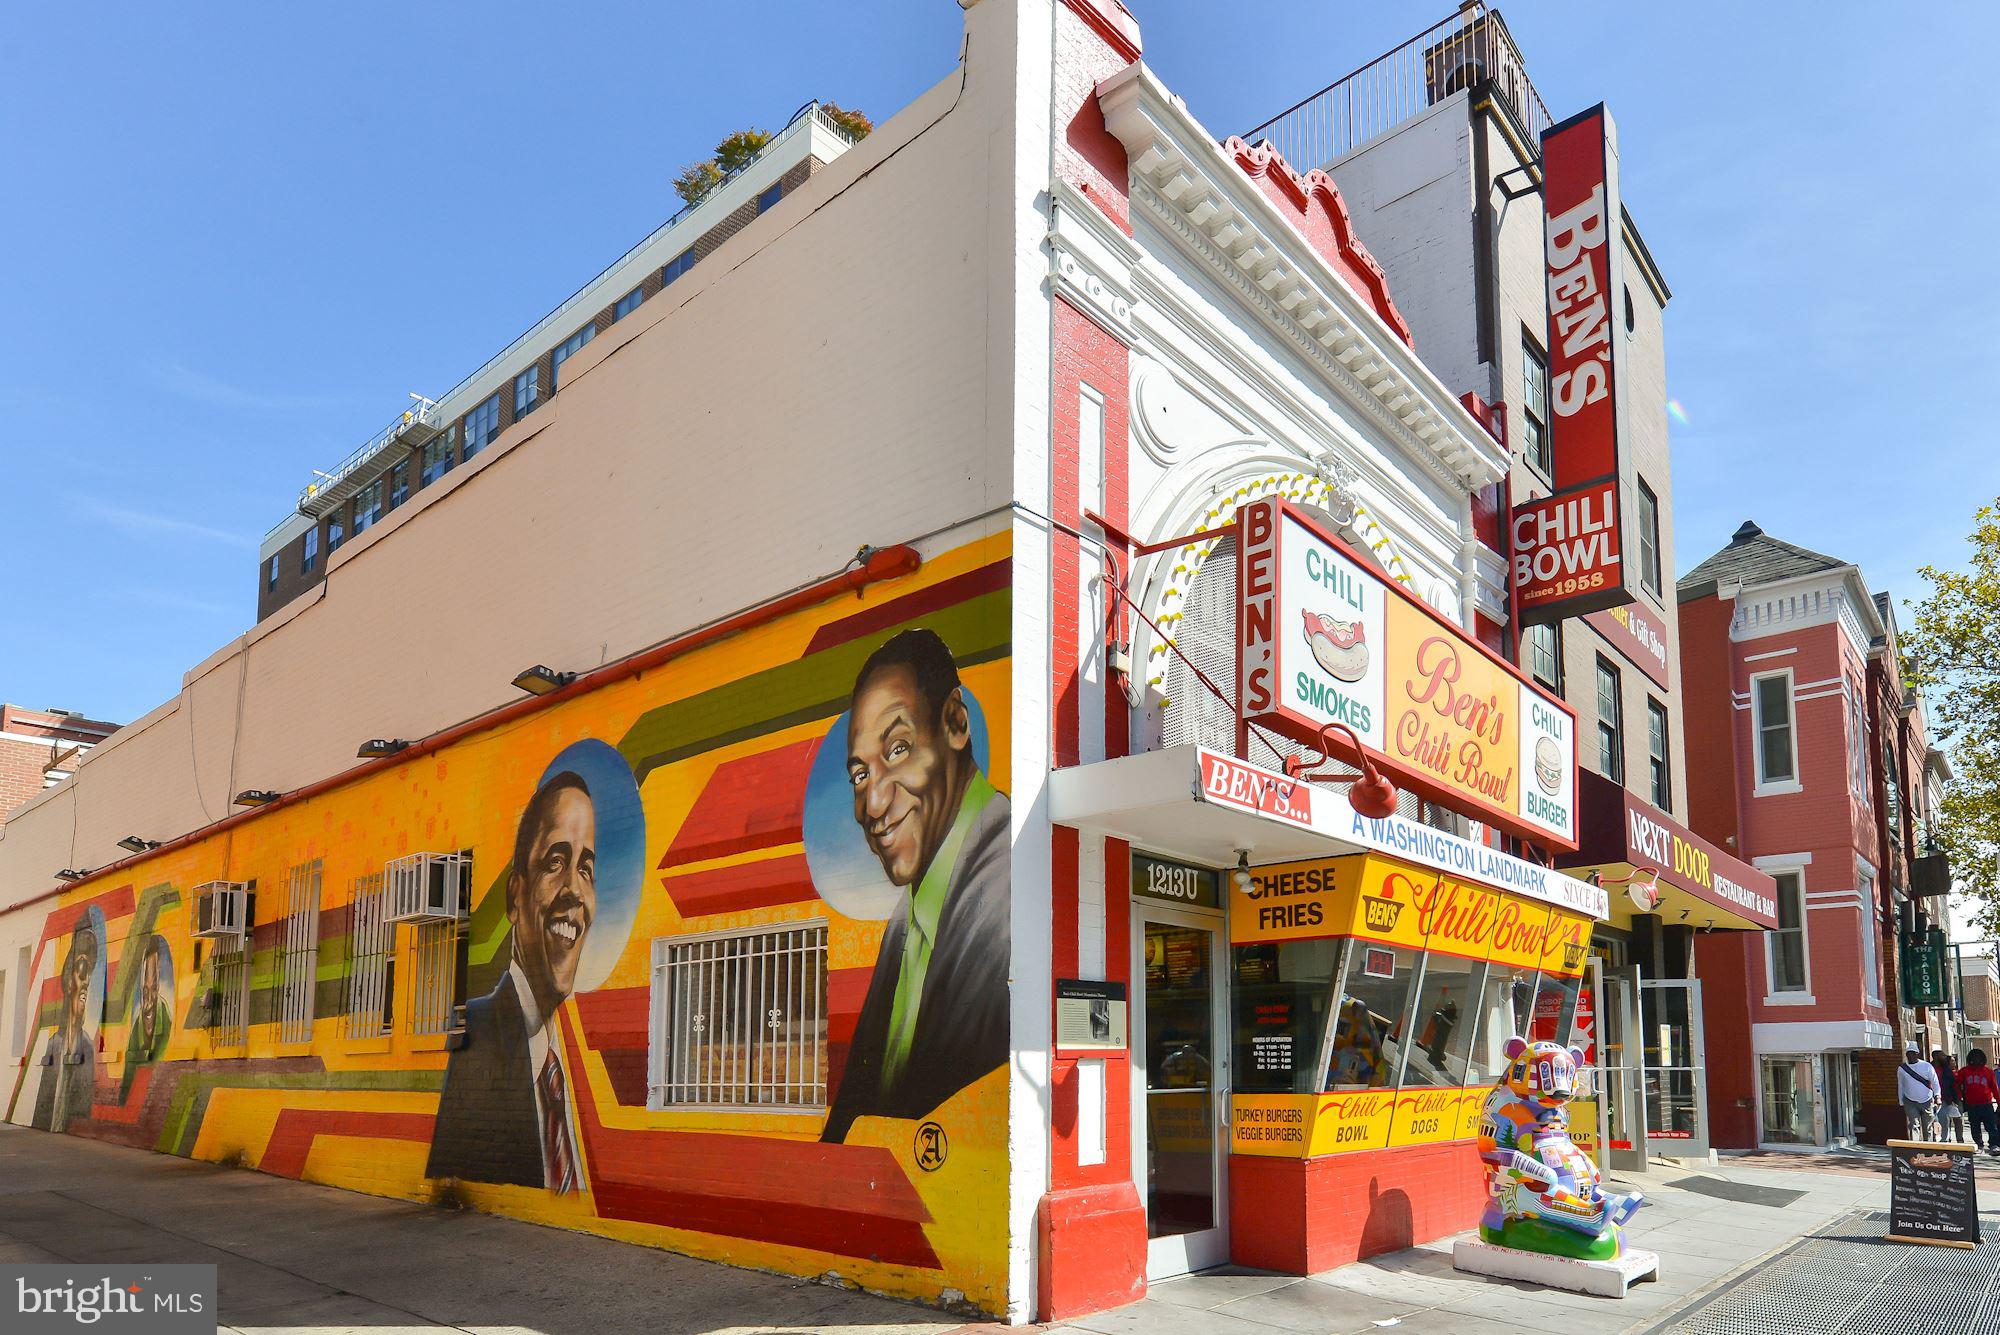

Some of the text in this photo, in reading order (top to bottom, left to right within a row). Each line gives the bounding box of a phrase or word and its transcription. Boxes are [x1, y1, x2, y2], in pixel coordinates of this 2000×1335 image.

[1546, 182, 1611, 417] BEN'S
[1513, 490, 1613, 551] CHILI
[1515, 532, 1619, 587] BOWL
[1306, 548, 1364, 612] CHILI
[1524, 572, 1604, 600] since 1958
[1246, 502, 1273, 711] BEN'S
[1636, 618, 1649, 648] Gift
[1649, 630, 1666, 669] Shop
[1296, 672, 1371, 733] SMOKES
[1405, 636, 1504, 746] Ben's
[1532, 703, 1563, 741] CHILI
[1396, 709, 1513, 803] Chili Bowl
[1527, 791, 1568, 830] BURGER
[1352, 812, 1366, 838] A
[1370, 819, 1475, 872] WASHINGTON
[1479, 850, 1548, 894] LANDMARK
[1563, 881, 1591, 908] SINCE
[1673, 835, 1711, 888] DOOR
[1713, 873, 1756, 910] RESTAURANT
[1762, 897, 1776, 918] BAR
[1248, 868, 1336, 900] CHEESE
[1259, 902, 1324, 930] FRIES
[1367, 901, 1398, 928] BEN'S
[1416, 880, 1561, 957] Chili Bowl
[1921, 953, 1931, 995] SALOON
[1235, 1108, 1303, 1123] TURKEY BURGERS
[1336, 1095, 1383, 1120] Chili
[1411, 1092, 1450, 1113] Chili
[1236, 1126, 1303, 1142] VEGGIE BURGERS
[1336, 1125, 1369, 1143] BOWL
[1410, 1118, 1439, 1135] DOGS
[1897, 1220, 1913, 1228] Join
[1914, 1221, 1925, 1229] Us
[1925, 1222, 1941, 1231] Out
